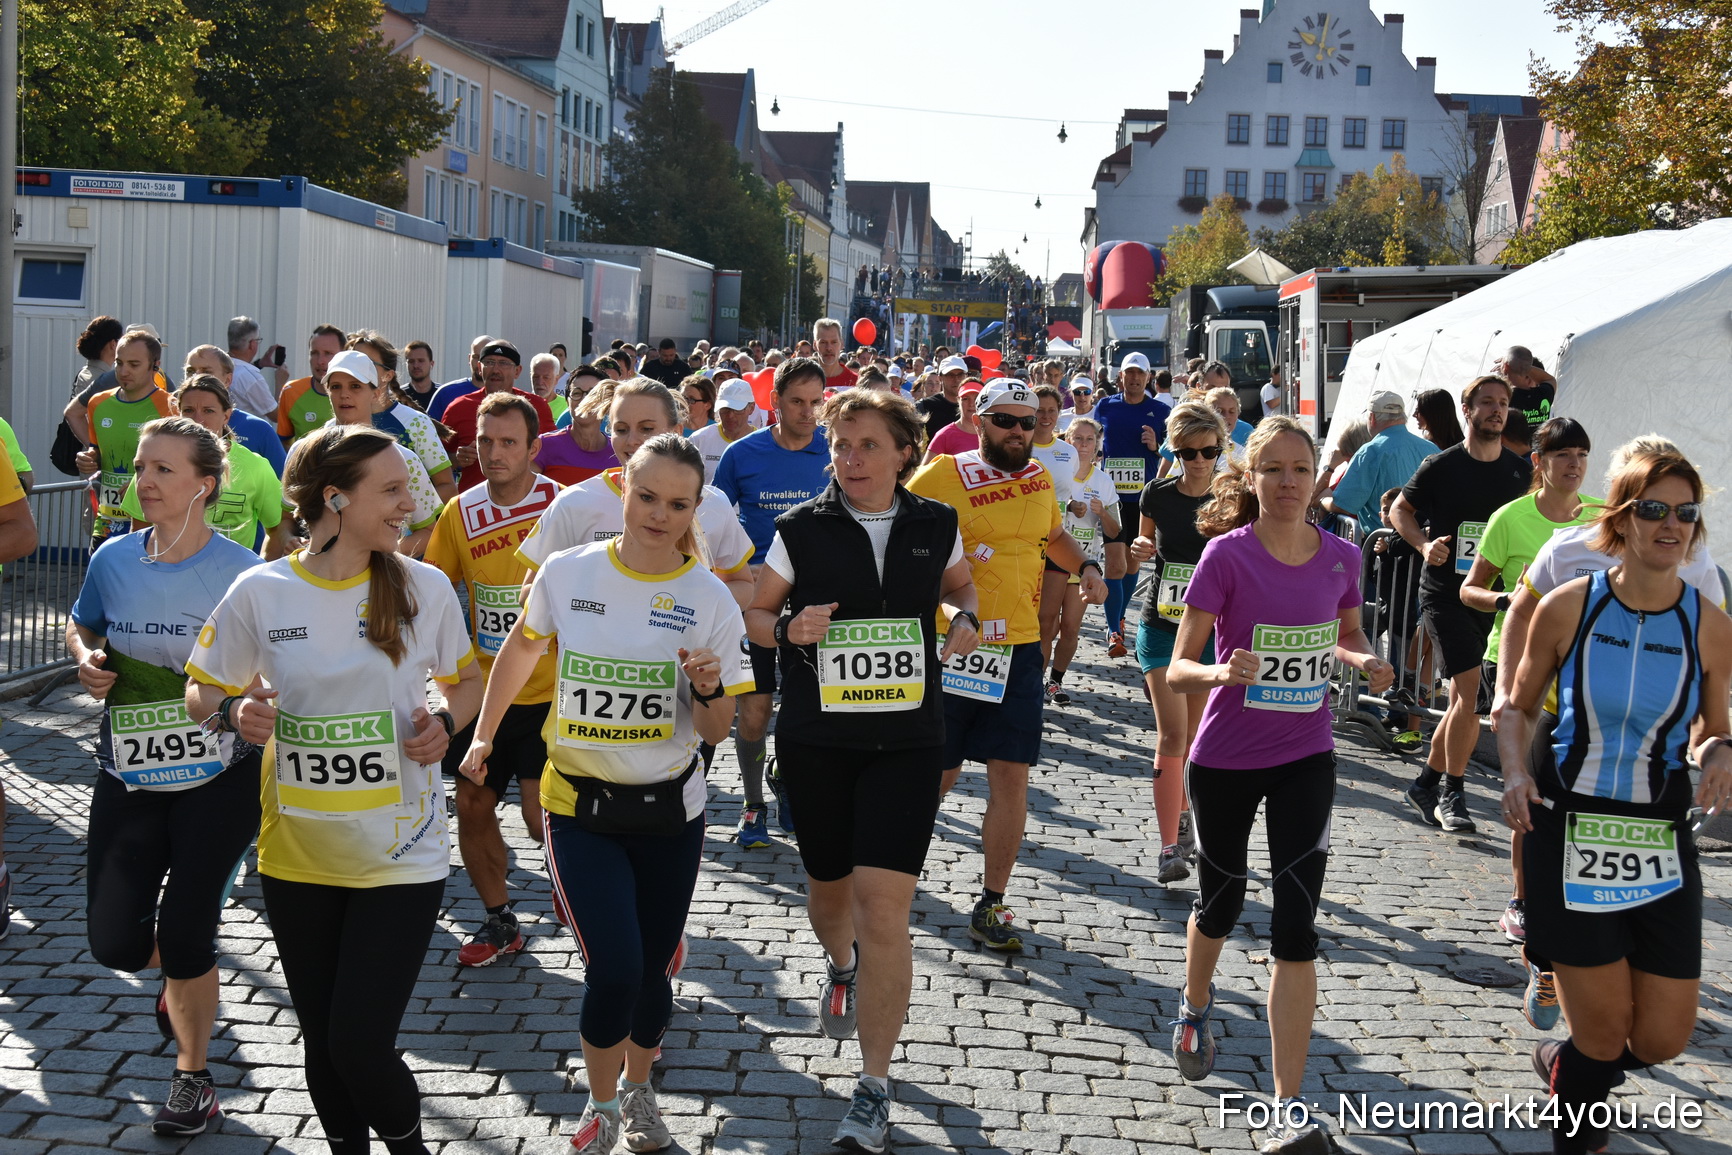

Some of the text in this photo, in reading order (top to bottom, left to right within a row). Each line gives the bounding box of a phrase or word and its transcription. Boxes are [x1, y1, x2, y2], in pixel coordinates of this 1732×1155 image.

[87, 180, 100, 188] TOI
[107, 181, 123, 189] DIXI
[131, 182, 150, 190] 08141
[130, 190, 177, 198] www.toitoidixi.de
[931, 303, 969, 314] START
[1523, 409, 1539, 417] hysio
[1526, 414, 1549, 424] umarkt
[1107, 459, 1141, 468] BOCK
[1109, 470, 1140, 482] 1118
[759, 489, 811, 500] Kirwaläufer
[969, 487, 1017, 508] MAX
[112, 509, 127, 517] RAL
[470, 533, 513, 560] MAX
[1167, 565, 1195, 580] BO
[571, 598, 606, 612] BOCK
[653, 596, 674, 611] 20
[479, 608, 519, 634] 238
[648, 619, 687, 634] Stadtlauf
[650, 610, 698, 627] Neumarkter
[269, 627, 308, 640] BOCK
[826, 622, 920, 645] BOCK
[1260, 625, 1334, 649] BOCK
[568, 655, 668, 686] BOCK
[831, 650, 914, 681] 1038
[1261, 652, 1331, 682] 2616
[943, 675, 990, 693] THOMAS
[841, 688, 906, 701] ANDREA
[572, 688, 663, 721] 1276
[280, 715, 386, 745] BOCK
[568, 723, 663, 740] FRANZISKA
[123, 730, 207, 766] 2495
[137, 767, 208, 784] DANIELA
[286, 751, 386, 786] 1396
[1575, 818, 1668, 846] BOCK
[391, 842, 414, 861] 14./15.
[1577, 849, 1664, 882] 2591
[1593, 887, 1652, 903] SILVIA
